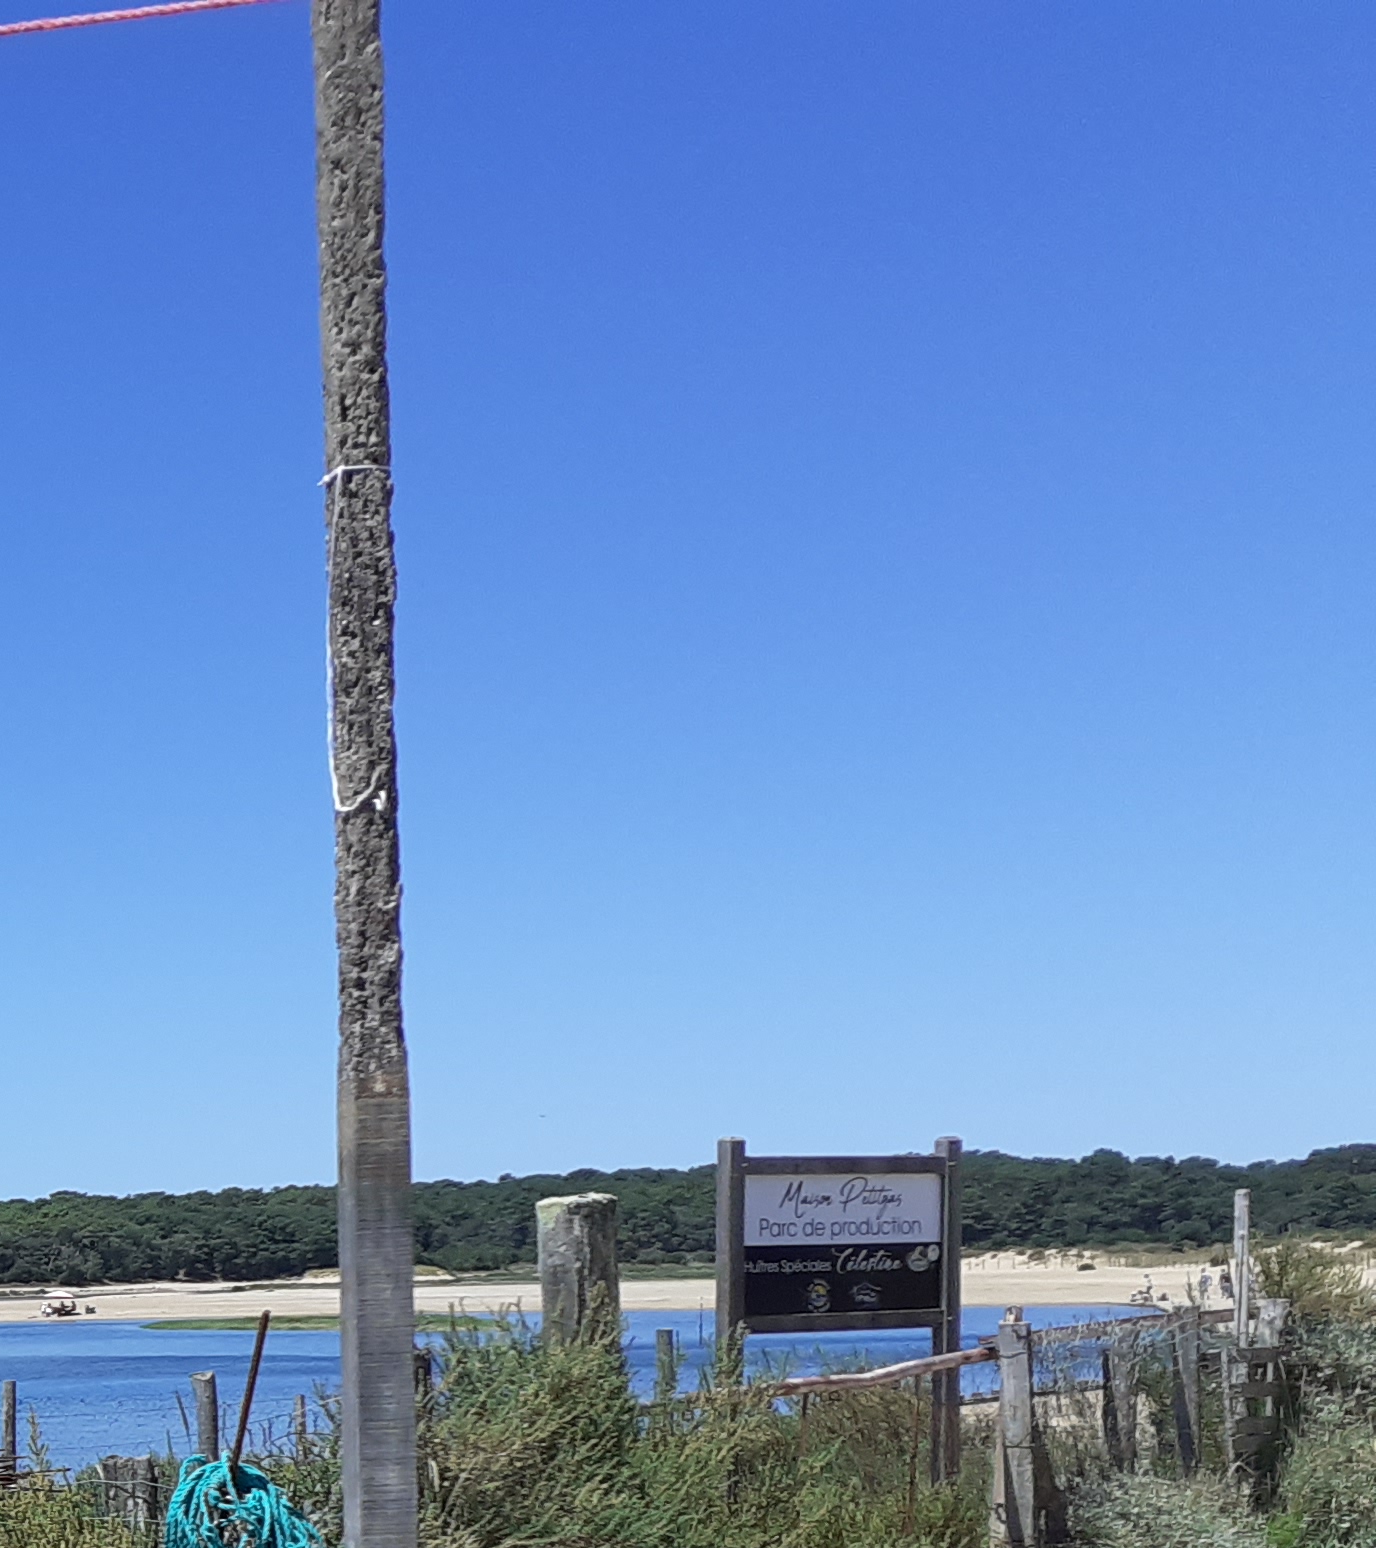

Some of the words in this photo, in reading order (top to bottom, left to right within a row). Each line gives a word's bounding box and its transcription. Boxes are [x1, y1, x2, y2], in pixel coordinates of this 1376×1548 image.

[779, 1181, 832, 1218] Maison
[759, 1218, 797, 1237] Parc
[803, 1218, 826, 1237] de
[830, 1217, 922, 1240] production
[781, 1259, 832, 1274] Spéciales
